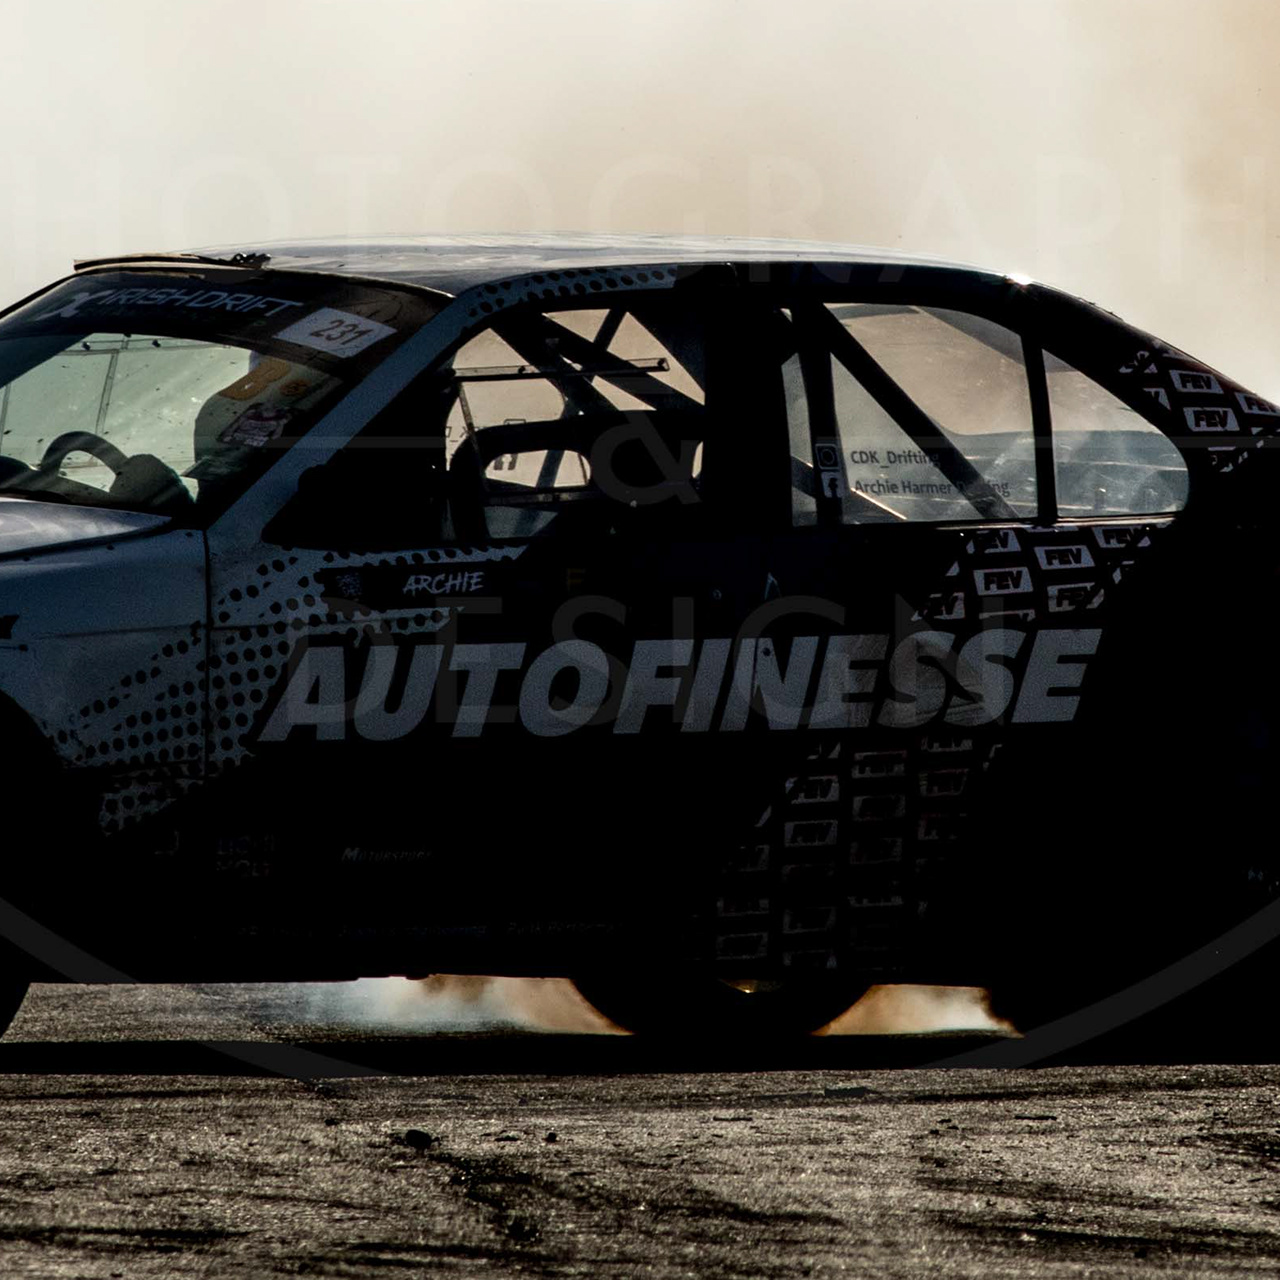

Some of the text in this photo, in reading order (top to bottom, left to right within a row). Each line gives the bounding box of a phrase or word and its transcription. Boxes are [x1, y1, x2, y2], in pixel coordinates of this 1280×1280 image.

[309, 318, 374, 346] 231
[1192, 409, 1229, 429] FEV
[854, 479, 899, 494] Archie
[902, 480, 952, 494] Harmer
[1043, 547, 1083, 567] FEV
[402, 570, 486, 597] ARCHIE
[983, 569, 1024, 592] FEV
[257, 628, 1103, 743] AUTOFINESSE
